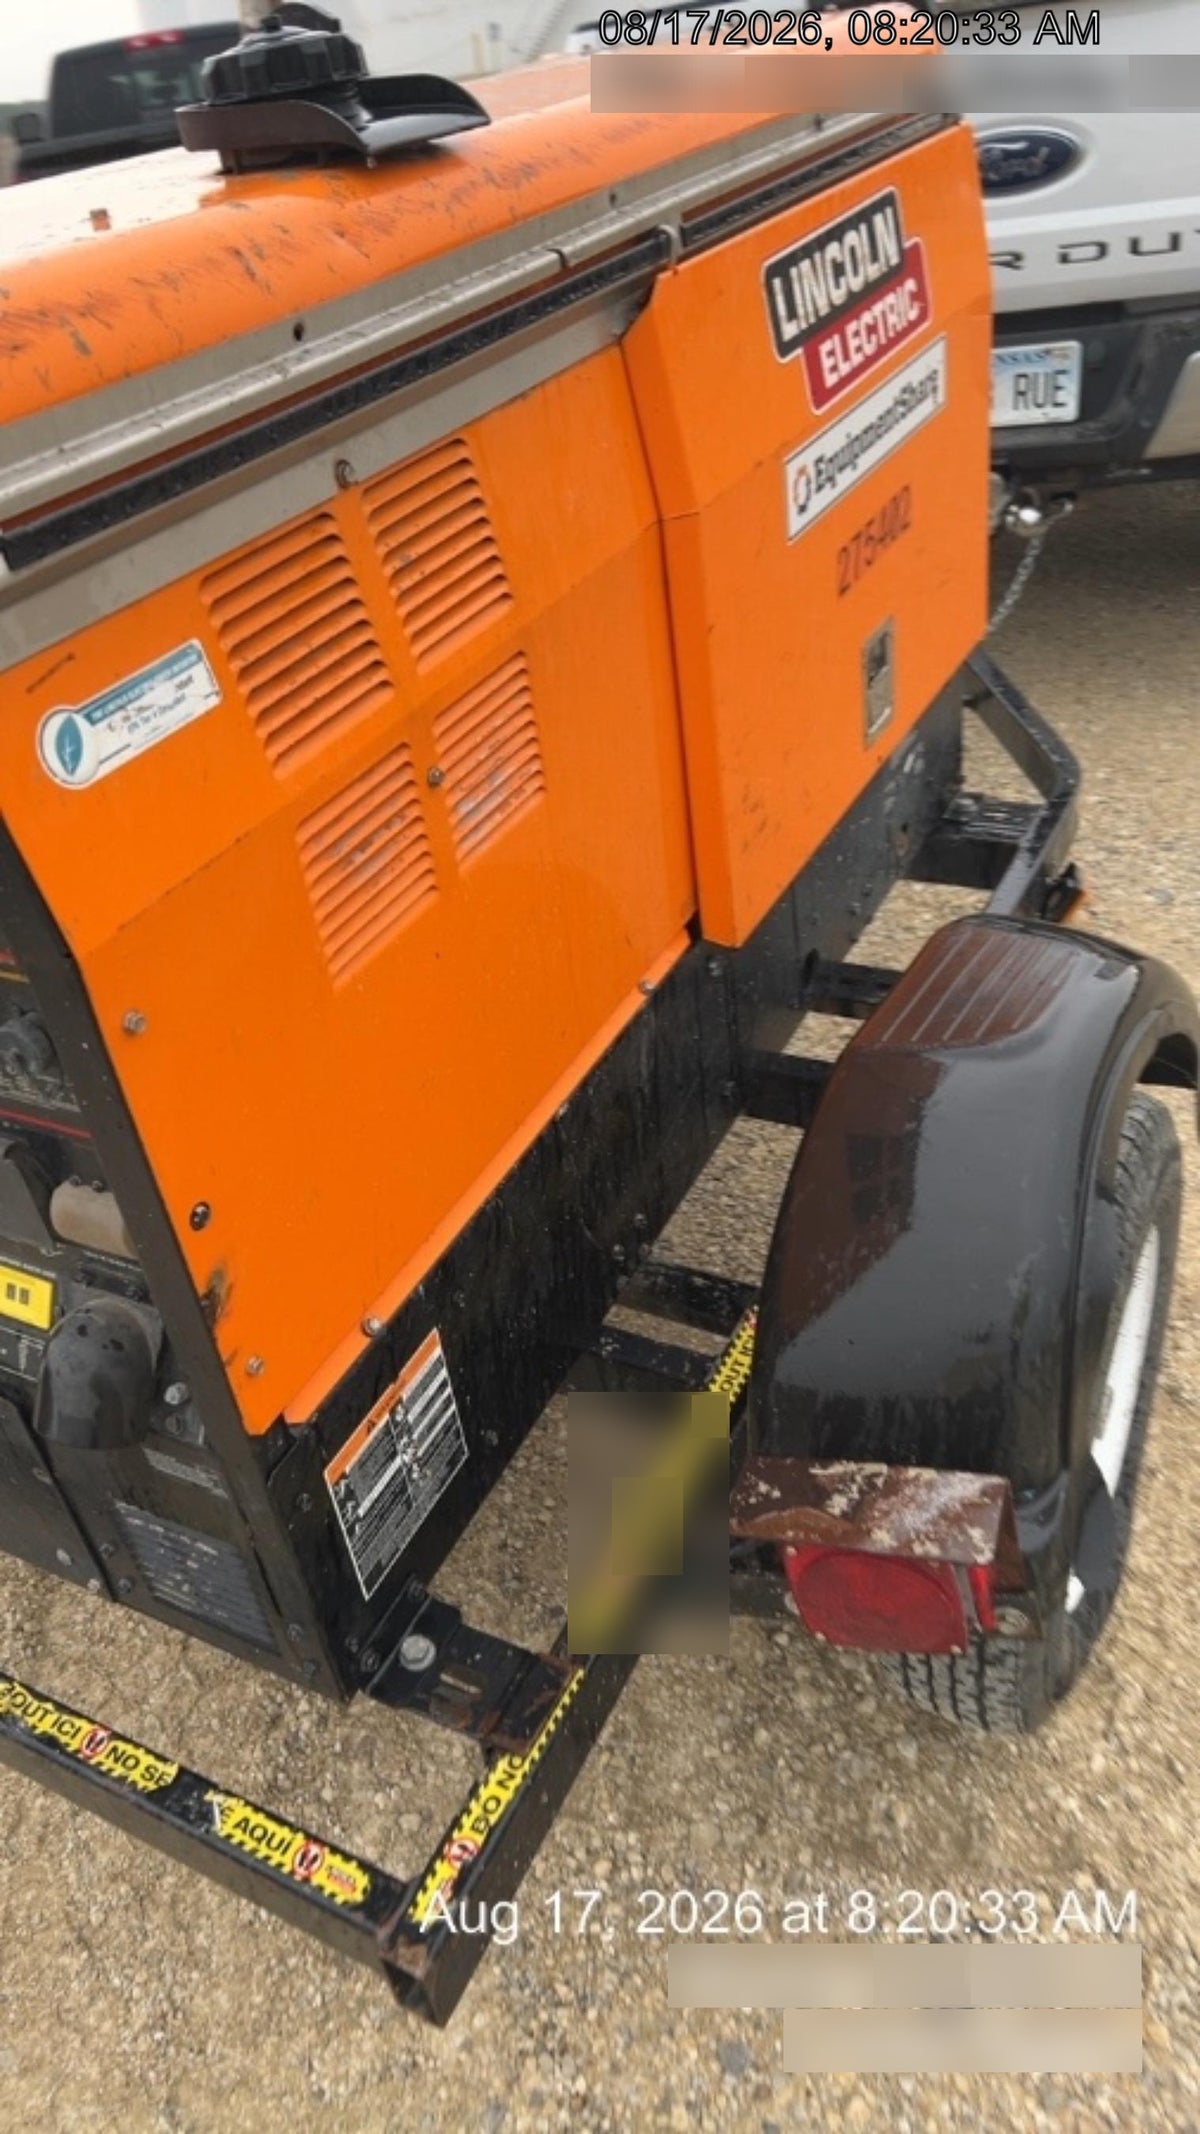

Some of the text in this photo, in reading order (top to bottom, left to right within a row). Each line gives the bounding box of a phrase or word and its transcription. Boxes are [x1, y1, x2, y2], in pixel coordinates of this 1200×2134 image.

[772, 205, 899, 344] LINCOLN
[1057, 230, 1200, 266] DU
[817, 278, 921, 389] ELECTRIC
[814, 368, 939, 494] EquipmentShare
[1012, 370, 1070, 411] RUE
[51, 1714, 82, 1740] ICI
[106, 1744, 141, 1771] NO
